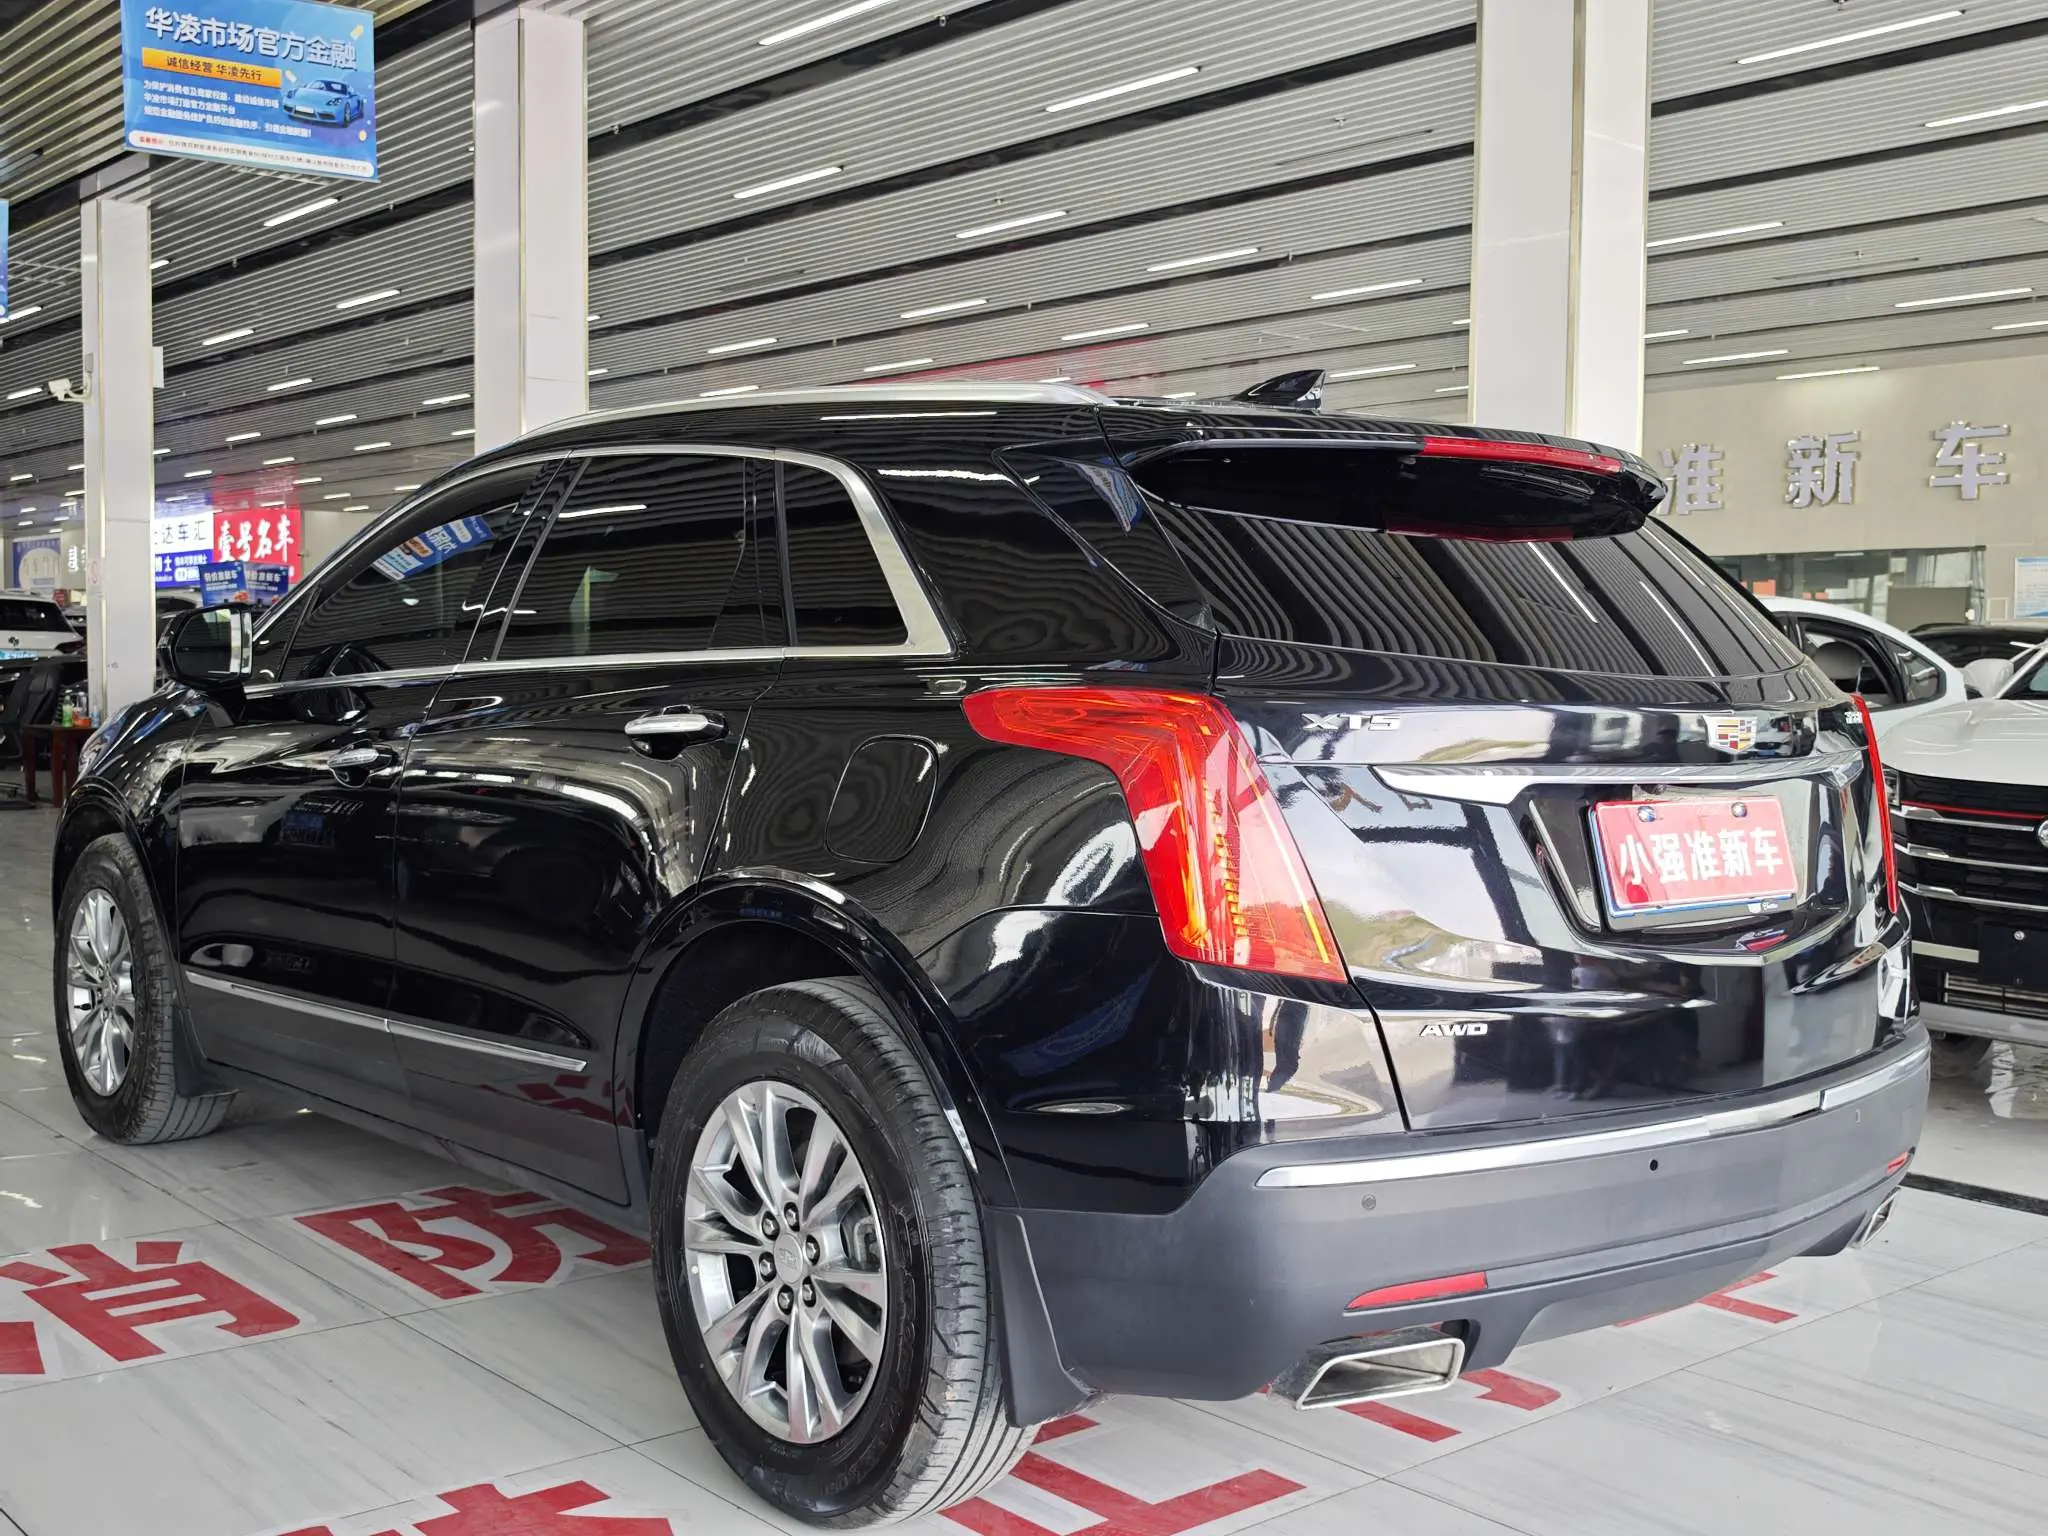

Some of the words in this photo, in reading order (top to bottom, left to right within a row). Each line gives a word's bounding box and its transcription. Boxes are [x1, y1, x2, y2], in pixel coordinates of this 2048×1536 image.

[144, 6, 358, 71] 华凌市场官方金融
[165, 55, 212, 73] 诚信经营
[215, 64, 263, 81] 华凌先行
[154, 519, 206, 545] 达车汇
[218, 514, 294, 562] 壹号名车
[1618, 826, 1784, 886] 小强准新车
[1420, 1023, 1489, 1037] AWD
